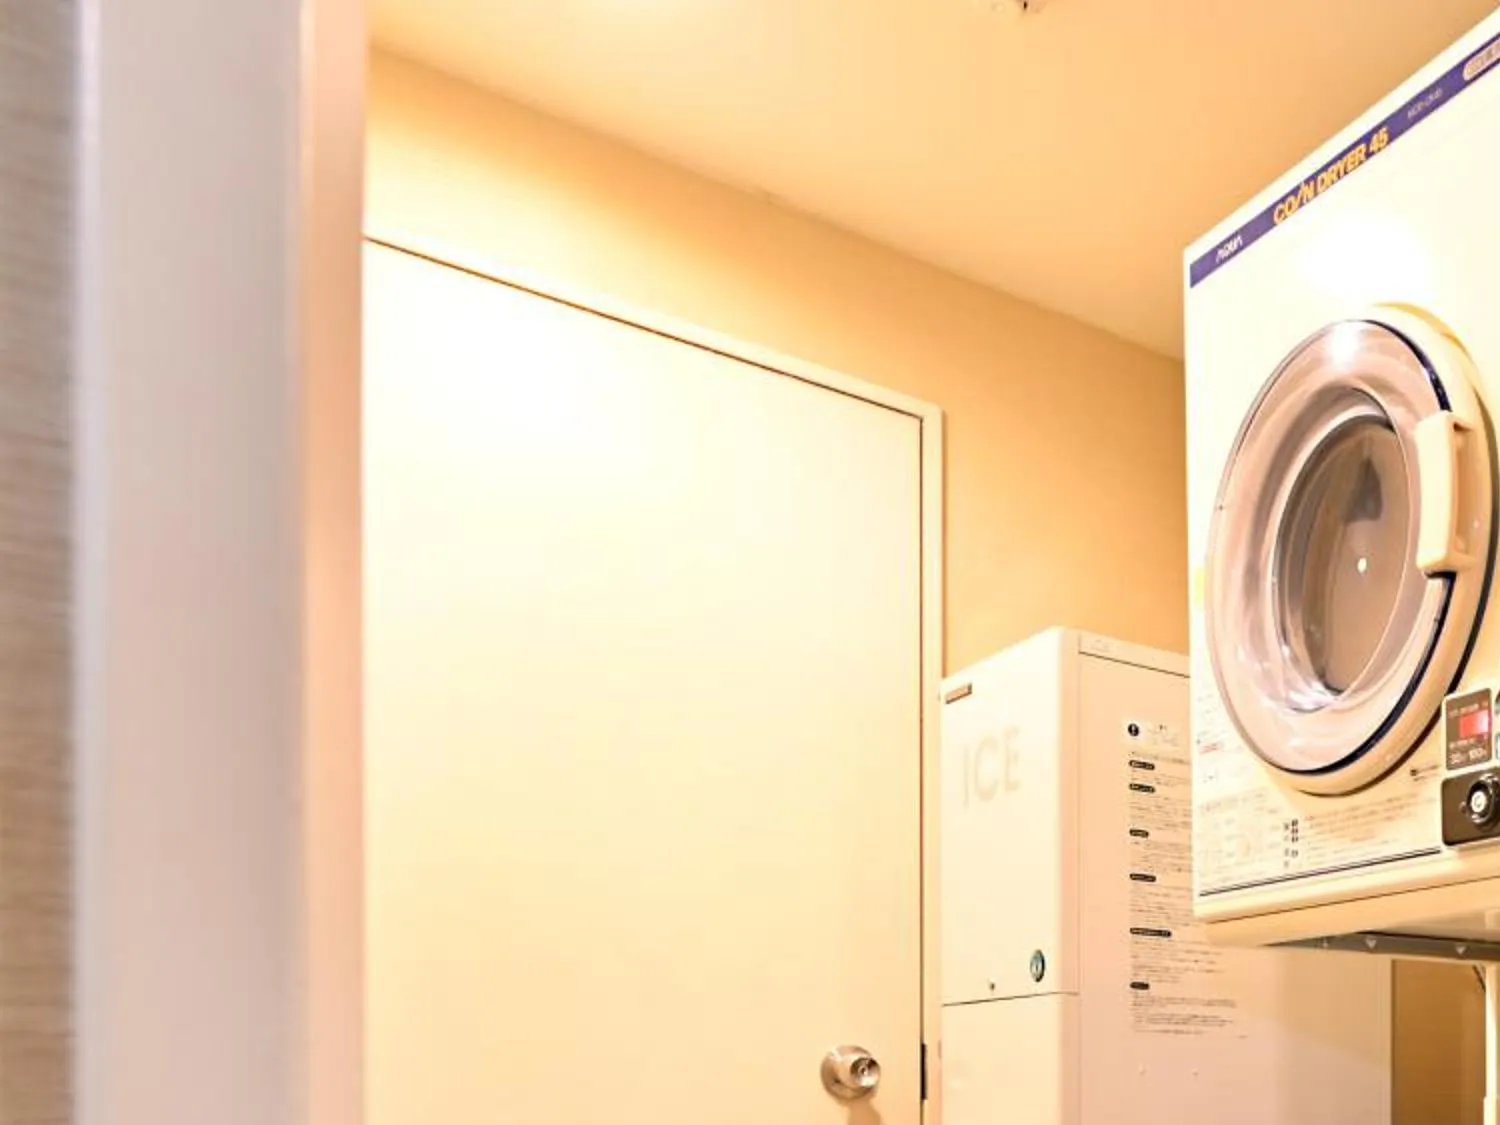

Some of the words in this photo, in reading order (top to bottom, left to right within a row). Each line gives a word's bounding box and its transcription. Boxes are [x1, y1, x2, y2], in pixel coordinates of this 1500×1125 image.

[1317, 143, 1368, 195] DRYER
[1369, 127, 1389, 154] 45
[962, 724, 1021, 809] ICE
